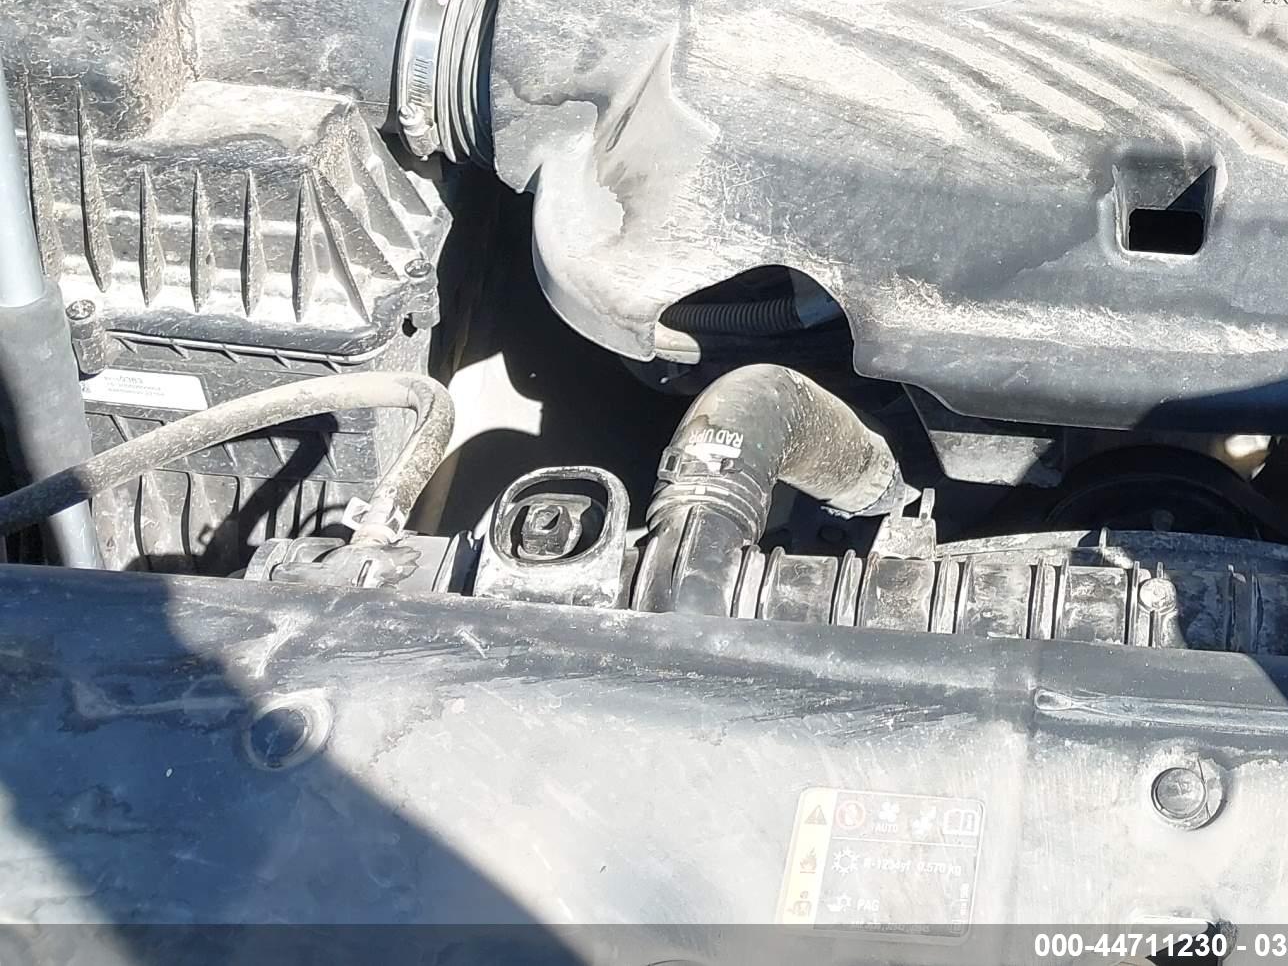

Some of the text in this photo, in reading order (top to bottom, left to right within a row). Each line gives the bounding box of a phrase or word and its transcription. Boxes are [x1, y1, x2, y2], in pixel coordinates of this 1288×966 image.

[689, 428, 744, 448] RAD UPR
[857, 898, 880, 912] PAG
